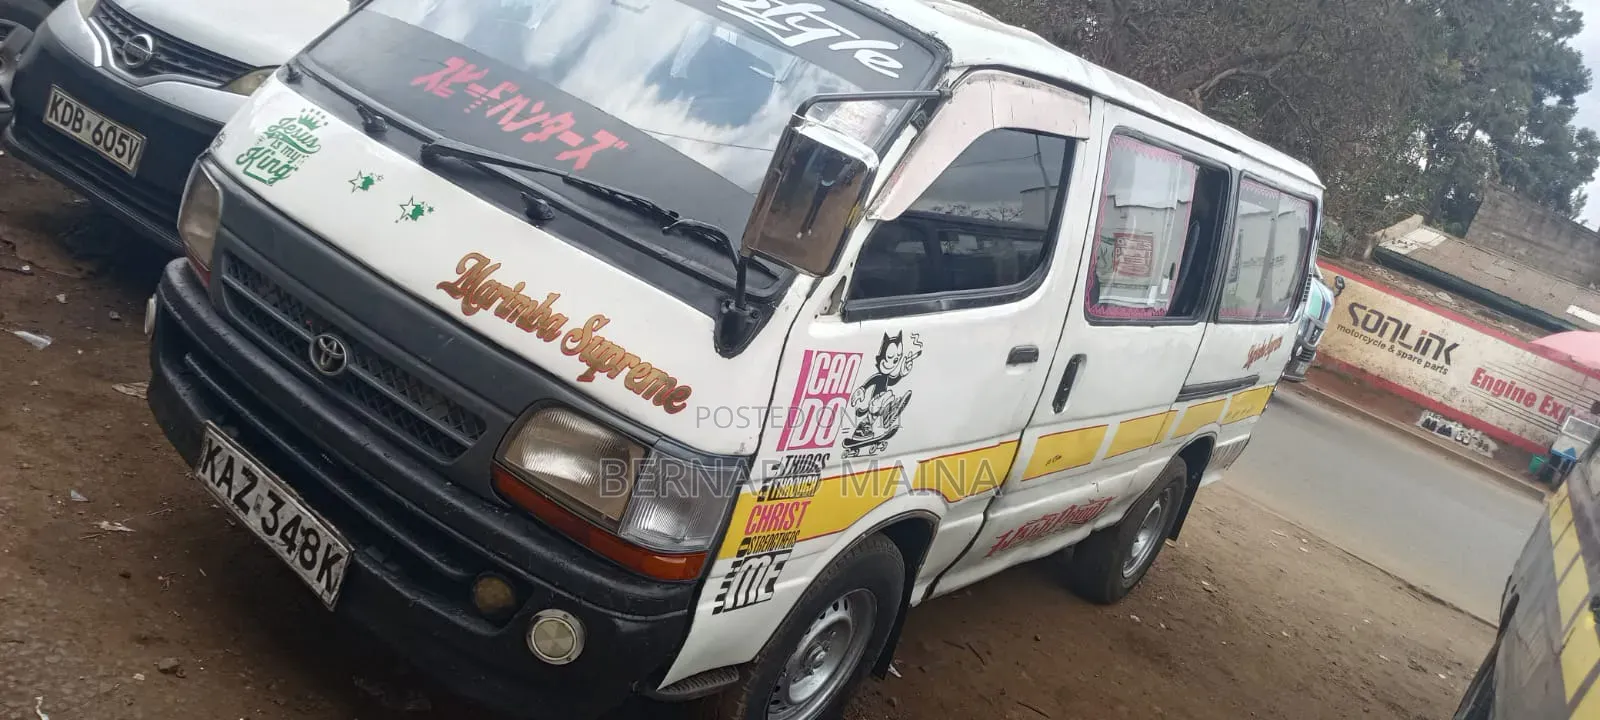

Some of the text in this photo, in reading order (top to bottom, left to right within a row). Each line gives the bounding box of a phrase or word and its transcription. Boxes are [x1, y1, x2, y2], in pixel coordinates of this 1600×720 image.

[49, 94, 139, 164] KDB 605V
[266, 117, 320, 150] Jesus
[236, 146, 299, 186] King
[270, 139, 302, 164] is my
[436, 252, 692, 414] Marimba Supreme
[1336, 323, 1449, 375] motorcycle & spare parts
[807, 352, 862, 395] CAN
[1470, 367, 1537, 408] Engine
[786, 397, 847, 446] DO
[781, 452, 831, 476] THINGS
[201, 438, 343, 593] KAZ 348K
[744, 500, 812, 535] CHRIST
[724, 551, 792, 611] ME
